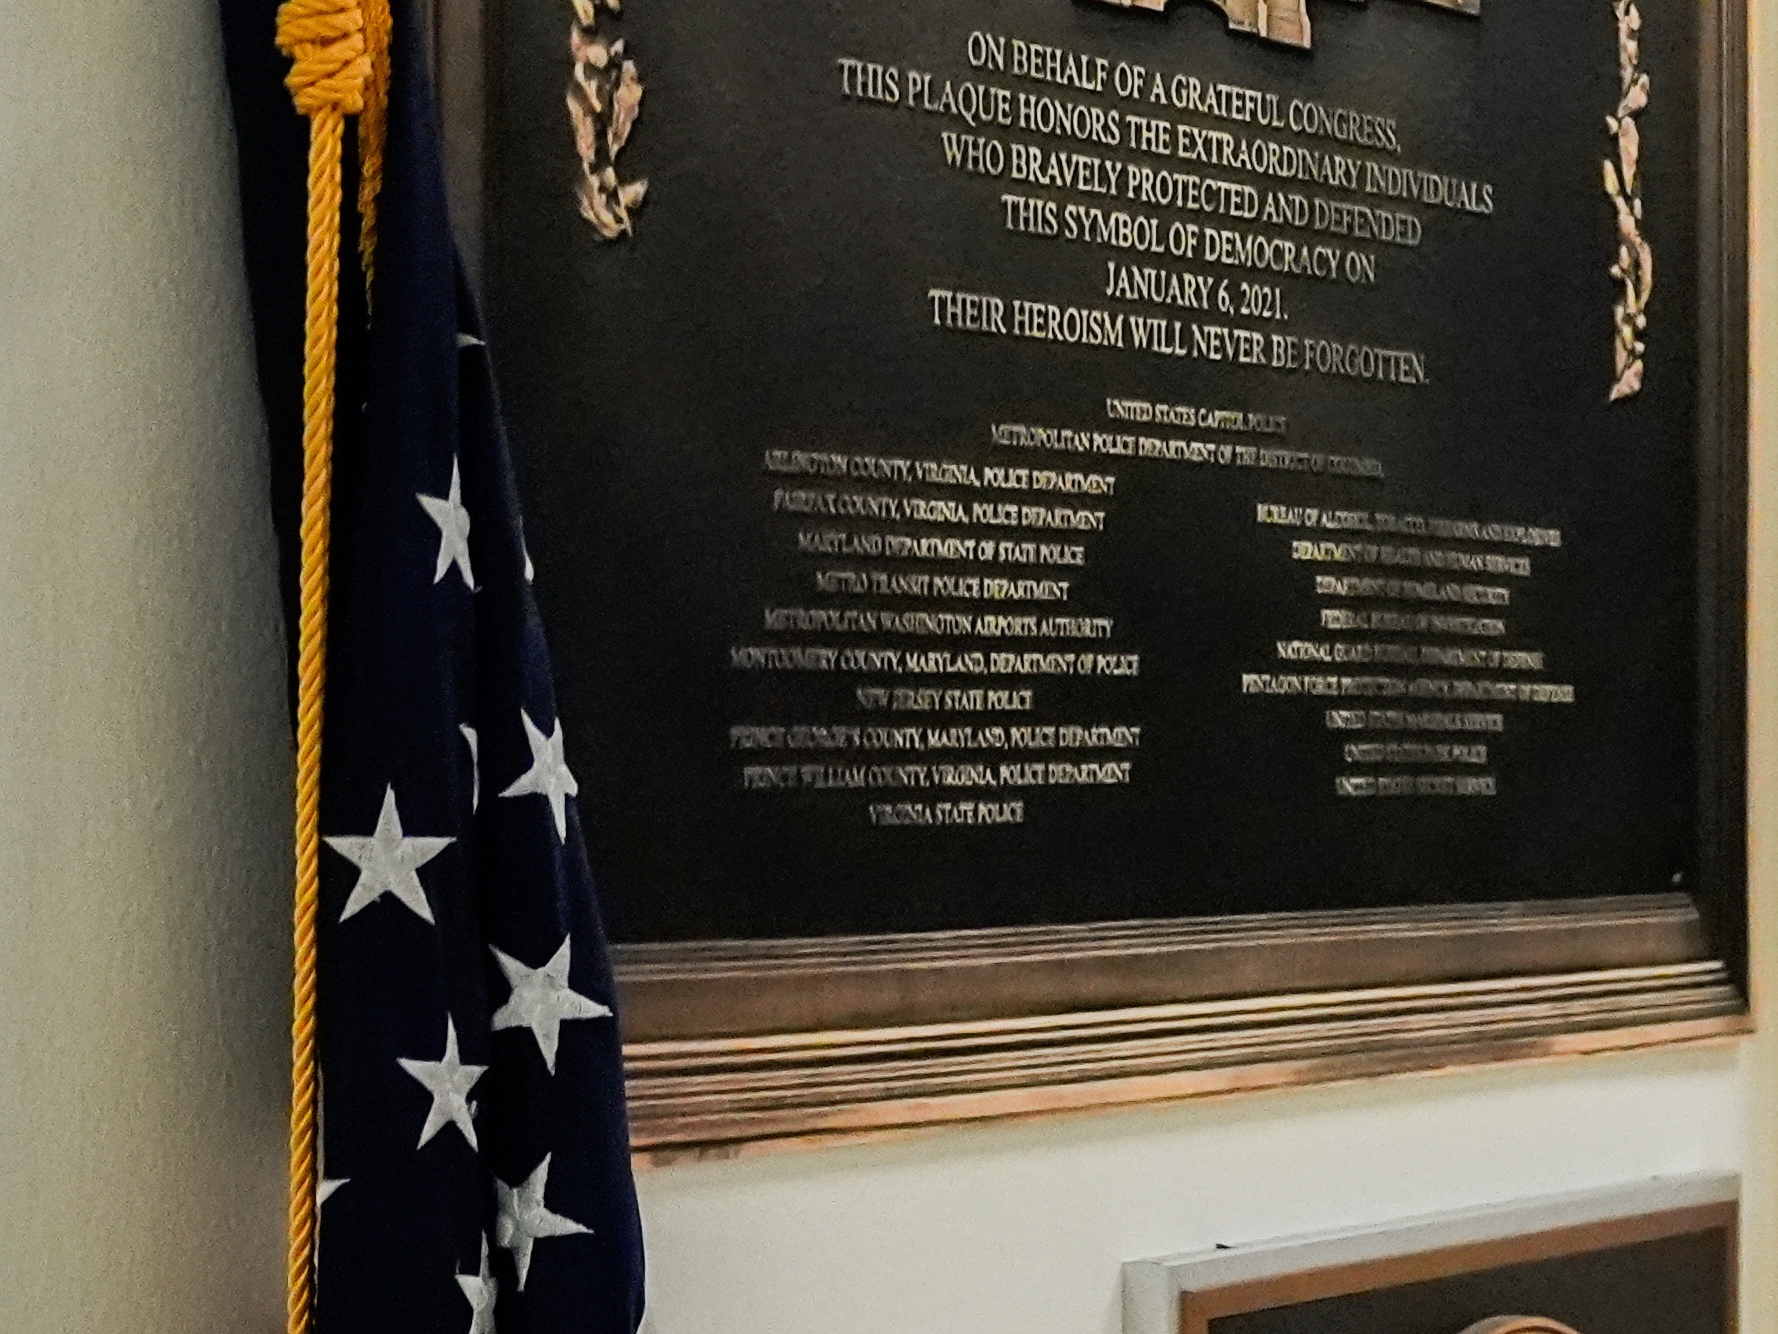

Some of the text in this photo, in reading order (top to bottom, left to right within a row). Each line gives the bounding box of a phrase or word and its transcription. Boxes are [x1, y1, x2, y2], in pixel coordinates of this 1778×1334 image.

[967, 30, 1006, 72] ON
[1011, 39, 1109, 93] BEHALF
[1113, 61, 1147, 100] OF
[1149, 68, 1168, 105] A
[1170, 72, 1285, 128] GRATEFUL
[837, 57, 1494, 214] THIS PLAQUE HONORS THE EXTRAORDINARY INDIVIDUALS
[940, 132, 1422, 246] WHO BRAVELY PROTECTED AND DEFENDED
[1000, 194, 1376, 283] THIS SYMBOL OF DEMOCRACY ON
[1105, 261, 1289, 320] JANUARY 6, 2021.
[927, 288, 1430, 385] THEIR HEROISM WILL NEVER BE FORGOTTEN.
[1105, 398, 1154, 421] UNITED
[1154, 403, 1197, 425] STATES
[1091, 432, 1137, 456] POLICE
[983, 466, 1030, 489] POLICE
[971, 502, 1020, 526] POLICE
[977, 541, 997, 560] OF
[1039, 544, 1086, 565] POLICE
[932, 576, 982, 597] POLICE
[1009, 727, 1056, 747] POLICE
